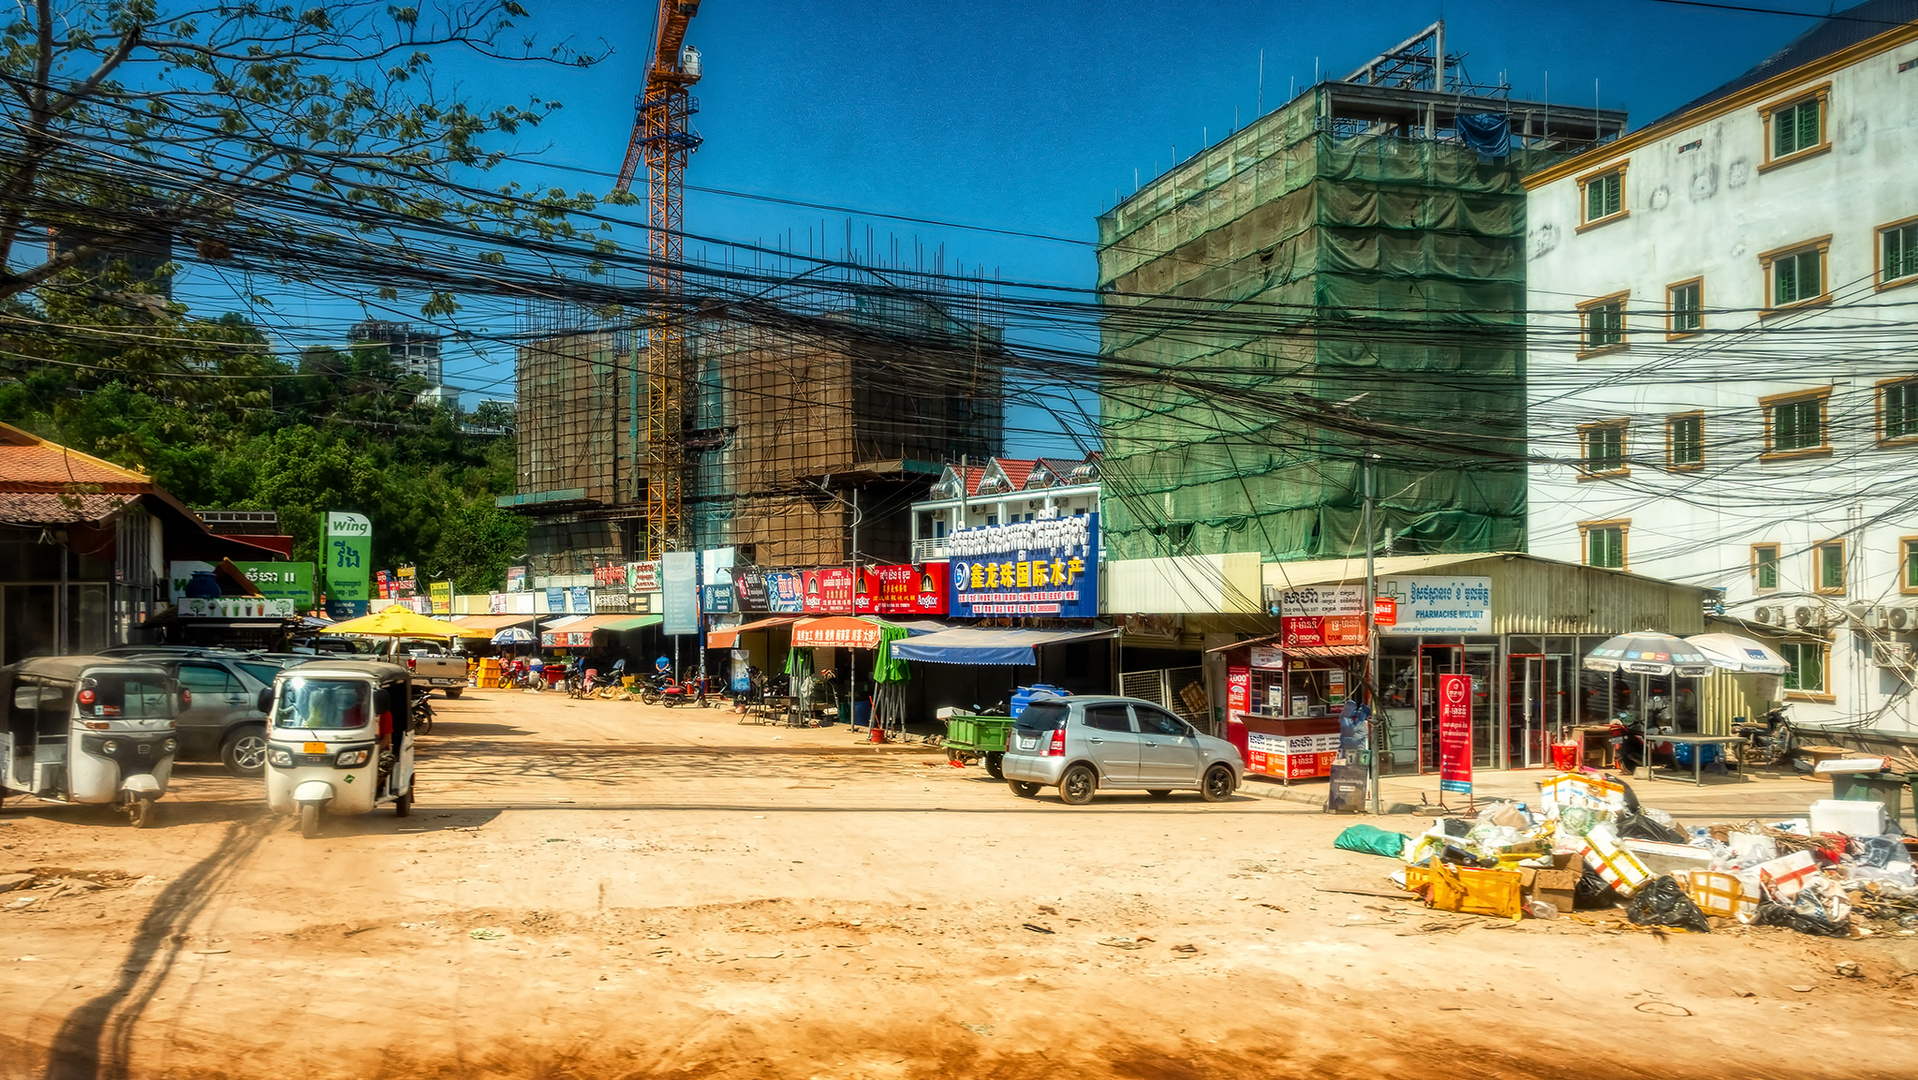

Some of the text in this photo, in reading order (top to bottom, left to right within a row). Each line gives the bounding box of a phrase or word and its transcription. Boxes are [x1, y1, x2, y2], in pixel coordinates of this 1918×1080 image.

[333, 519, 368, 535] Wing
[970, 556, 1085, 589] 鑫龙珠国际水产
[855, 596, 870, 609] ngkor
[917, 594, 938, 609] Angkor
[1415, 610, 1484, 619] PHARMACISE MULMIT
